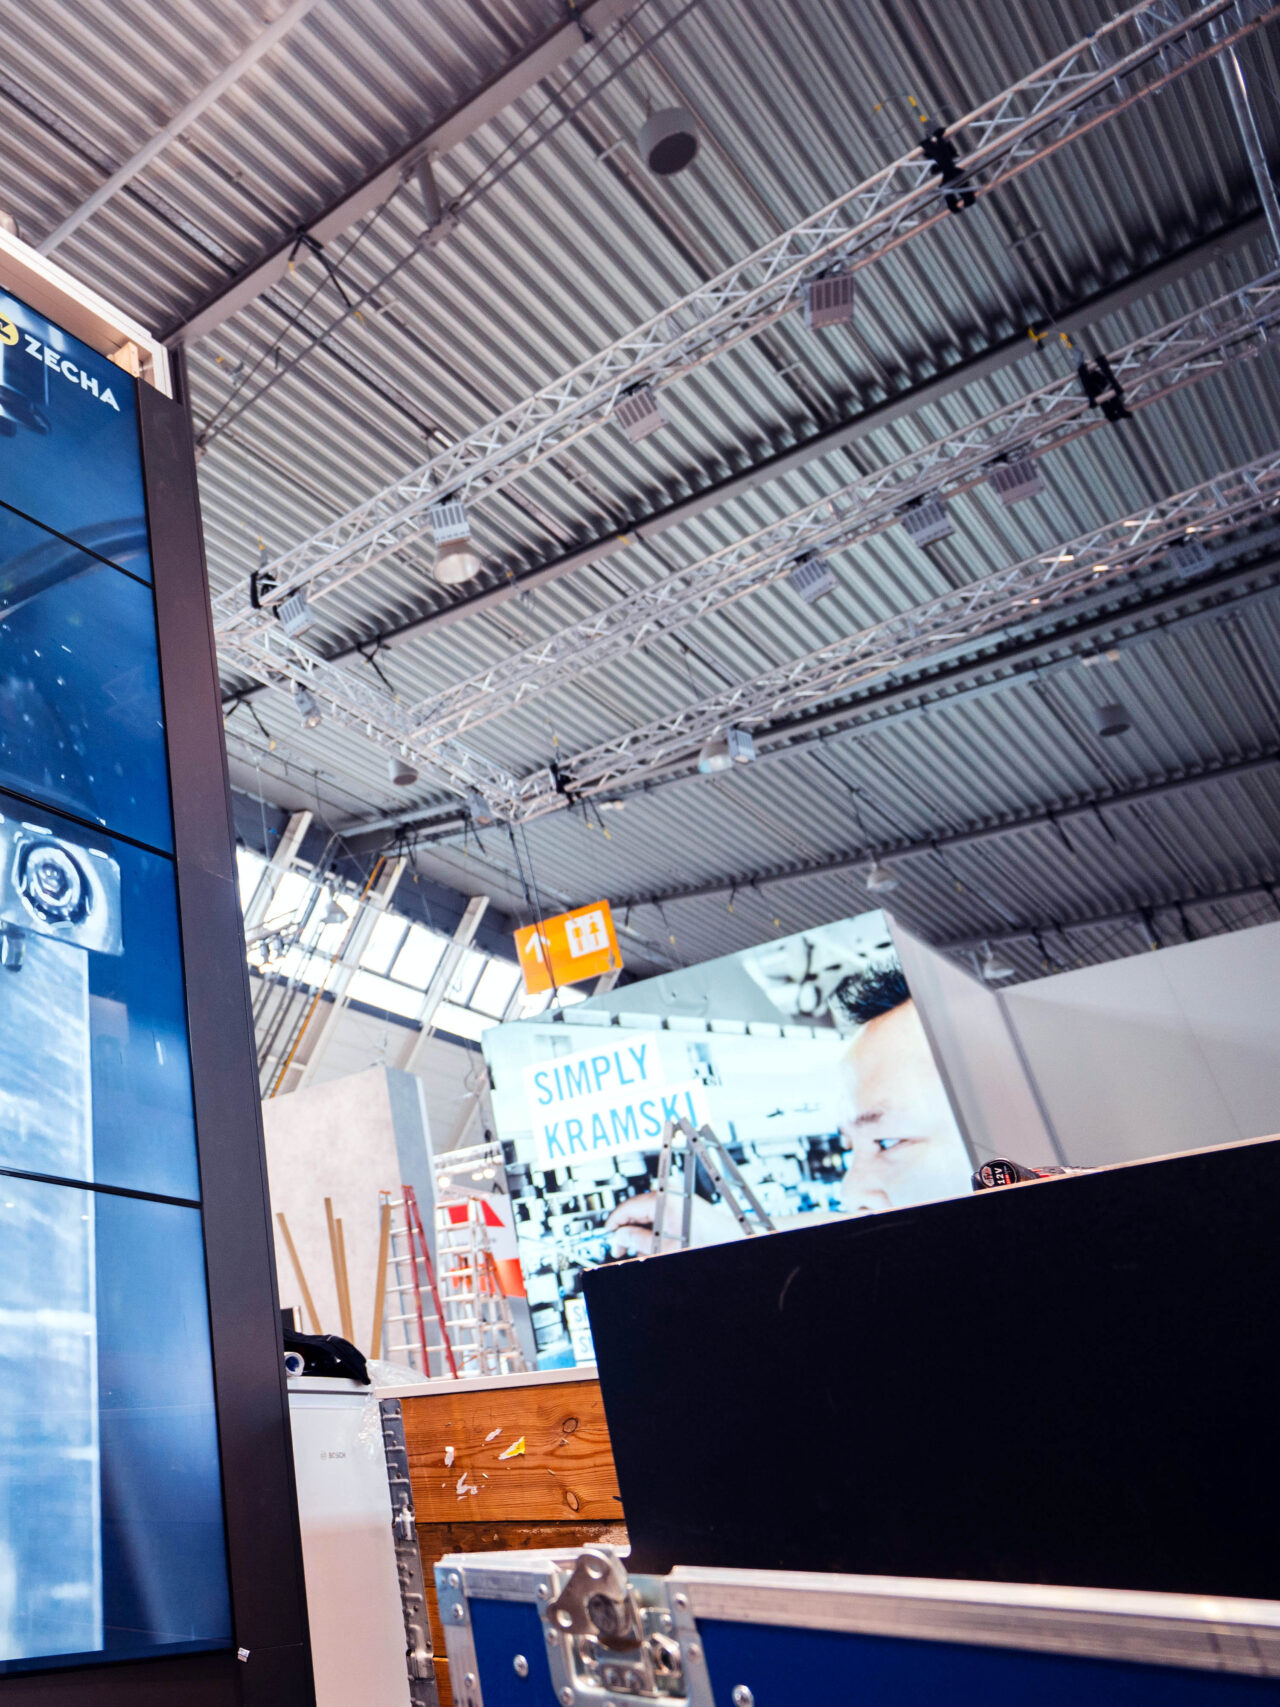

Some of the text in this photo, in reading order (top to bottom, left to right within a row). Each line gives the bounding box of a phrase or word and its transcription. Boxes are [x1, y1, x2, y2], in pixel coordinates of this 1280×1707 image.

[24, 334, 120, 412] ZECHA
[534, 1043, 647, 1105] SIMPLY
[544, 1091, 698, 1159] KRAMSKI
[994, 1167, 1006, 1185] 12V
